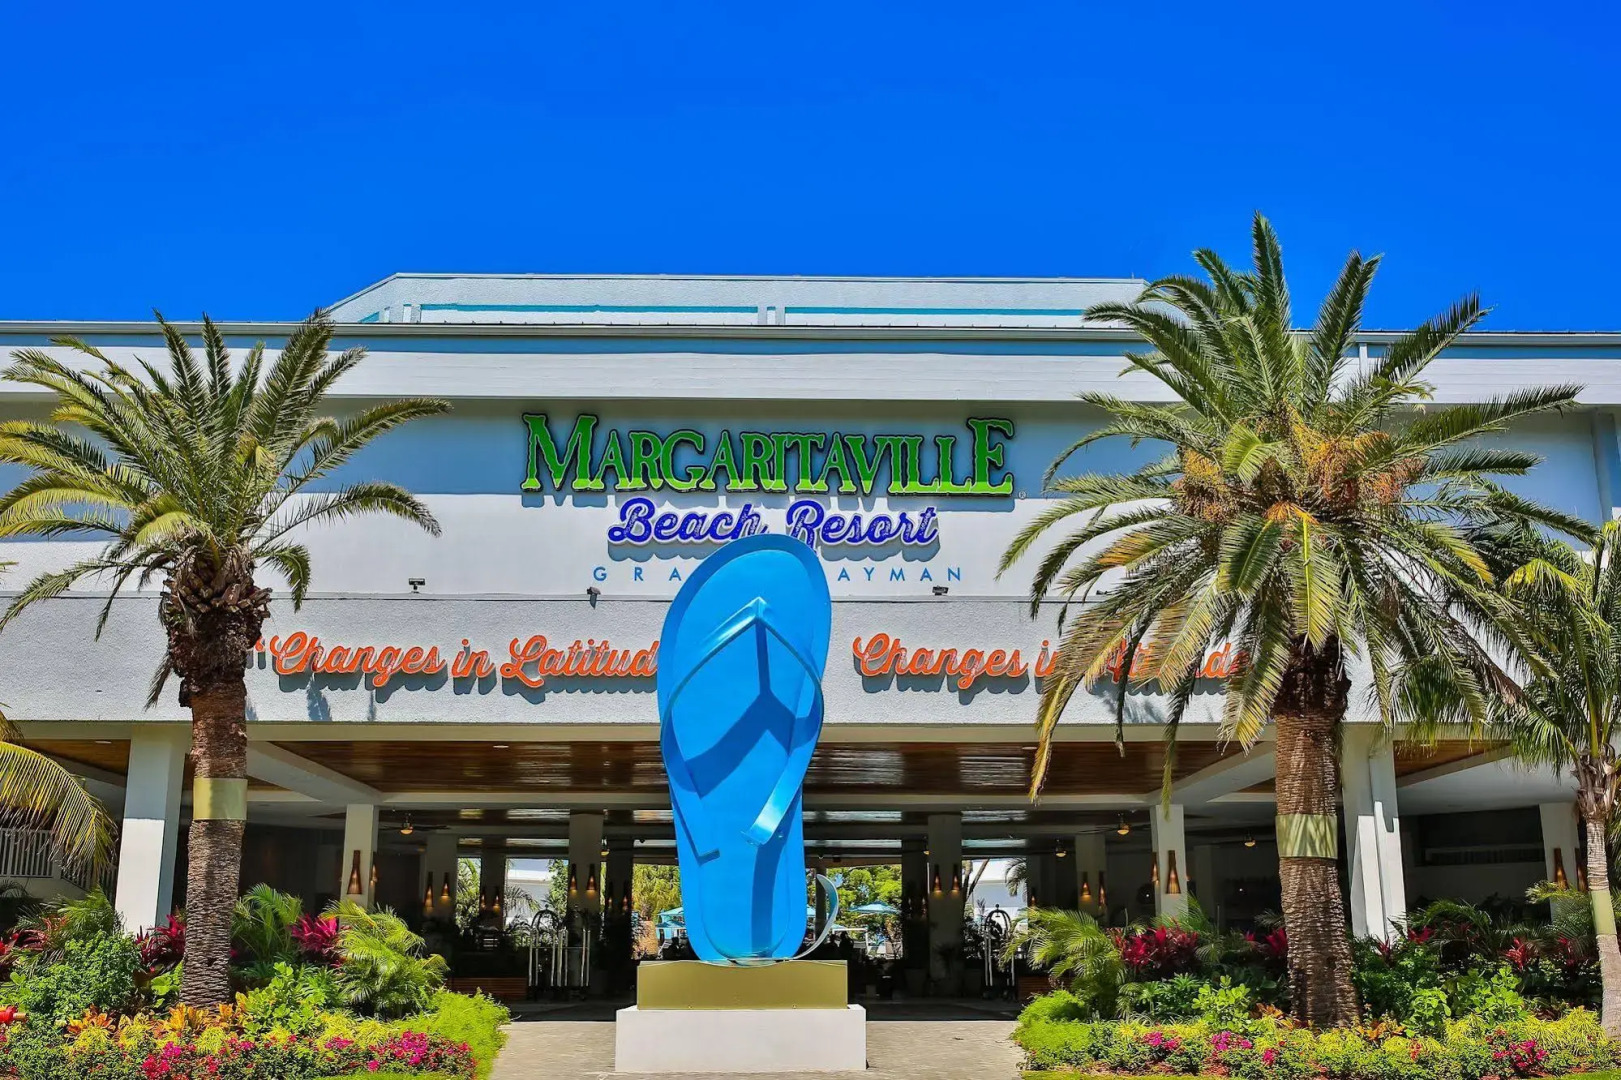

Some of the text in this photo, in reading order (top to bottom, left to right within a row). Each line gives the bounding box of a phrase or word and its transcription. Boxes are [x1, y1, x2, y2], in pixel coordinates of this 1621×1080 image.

[520, 412, 1014, 497] MARGARITAVILLE
[607, 497, 938, 554] Beach Resort
[593, 566, 961, 581] GRA AYMAN
[452, 639, 496, 677] in
[500, 635, 660, 688] Latitud
[853, 633, 1029, 689] Changes
